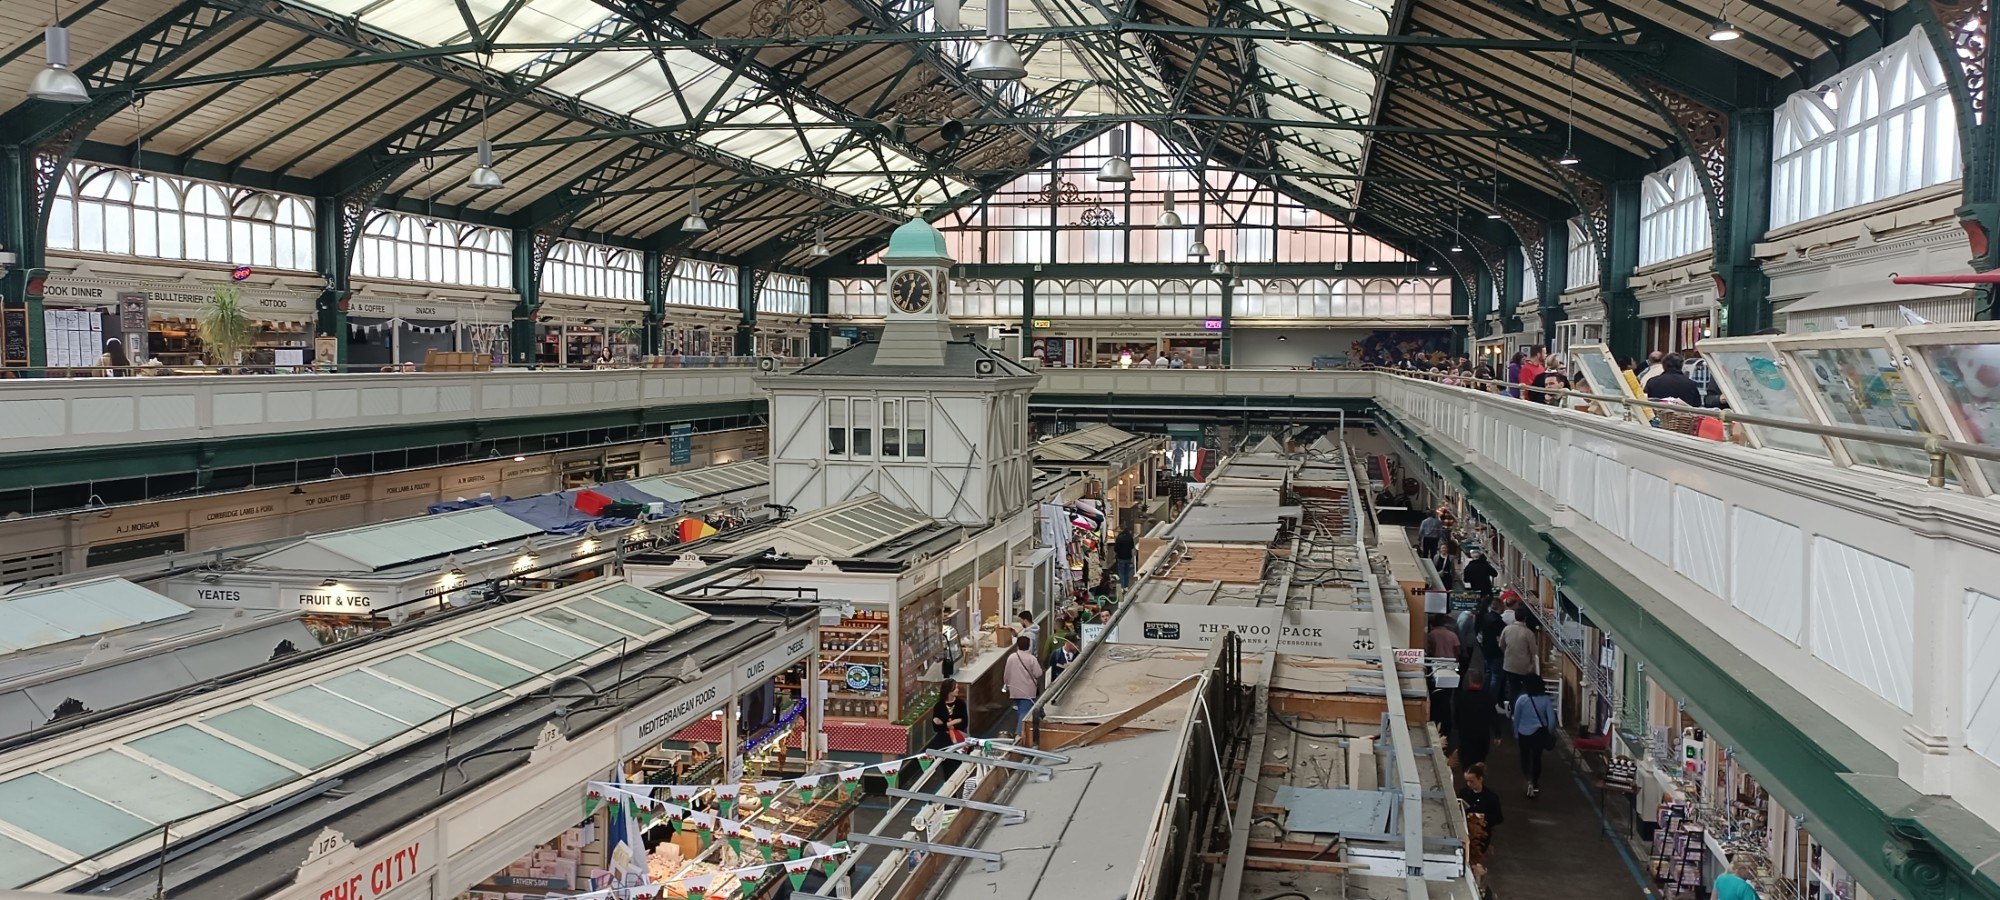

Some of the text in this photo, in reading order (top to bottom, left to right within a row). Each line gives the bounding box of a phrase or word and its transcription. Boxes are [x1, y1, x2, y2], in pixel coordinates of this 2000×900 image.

[43, 285, 103, 298] COOK DINNER
[155, 292, 203, 304] BULLTERRIER
[365, 304, 385, 313] COFFEE
[416, 307, 436, 315] SNACKS
[305, 493, 351, 506] TOP QUALITY BEEF
[131, 520, 160, 531] MORGAN
[198, 589, 240, 602] YEATES
[299, 594, 371, 607] FRUIT & VEG
[786, 638, 804, 656] CHEESE
[1277, 639, 1323, 647] CCESSORIES
[746, 660, 765, 679] OLIVES
[638, 686, 716, 739] MEDITERRANEAN FOODS
[544, 728, 556, 743] 173
[319, 835, 337, 855] 175
[371, 842, 420, 896] CITY
[512, 876, 549, 888] FATHER'S DAY
